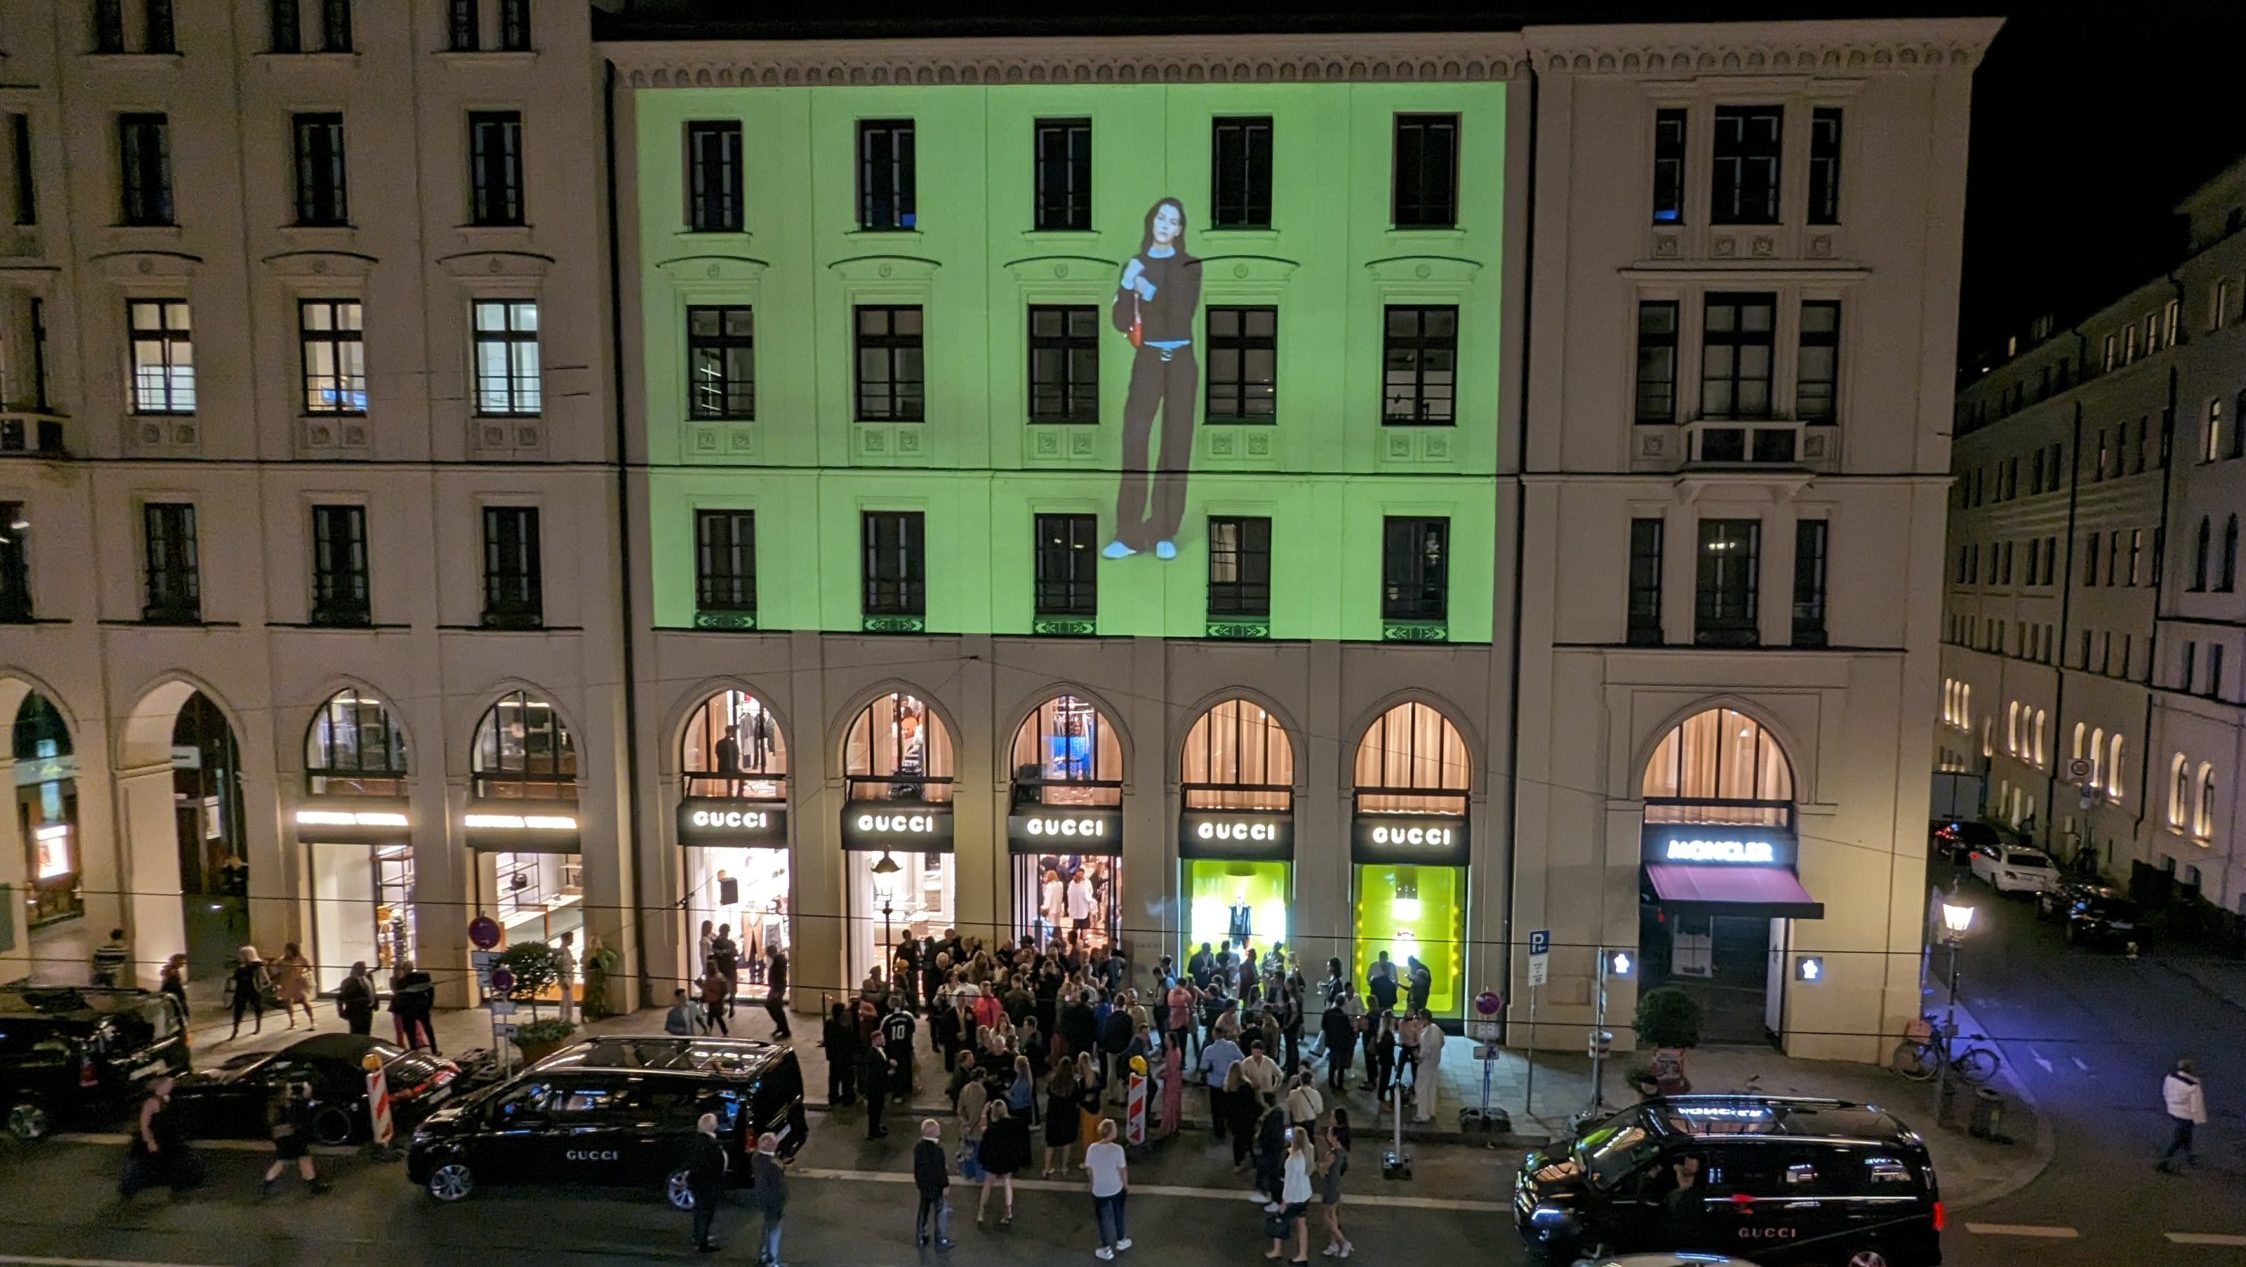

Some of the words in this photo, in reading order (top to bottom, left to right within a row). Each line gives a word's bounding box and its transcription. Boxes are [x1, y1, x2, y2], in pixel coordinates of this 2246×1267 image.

[692, 810, 767, 828] GUCCI
[857, 814, 933, 833] GUCCI
[1026, 818, 1103, 837] GUCCI
[1197, 822, 1276, 841] GUCCI
[1372, 826, 1451, 846] GUCCI
[1666, 839, 1774, 862] MONCLER
[1532, 933, 1544, 952] P
[891, 1024, 906, 1041] 10
[566, 1150, 618, 1160] GUCCI
[1738, 1227, 1796, 1238] GUCCI
